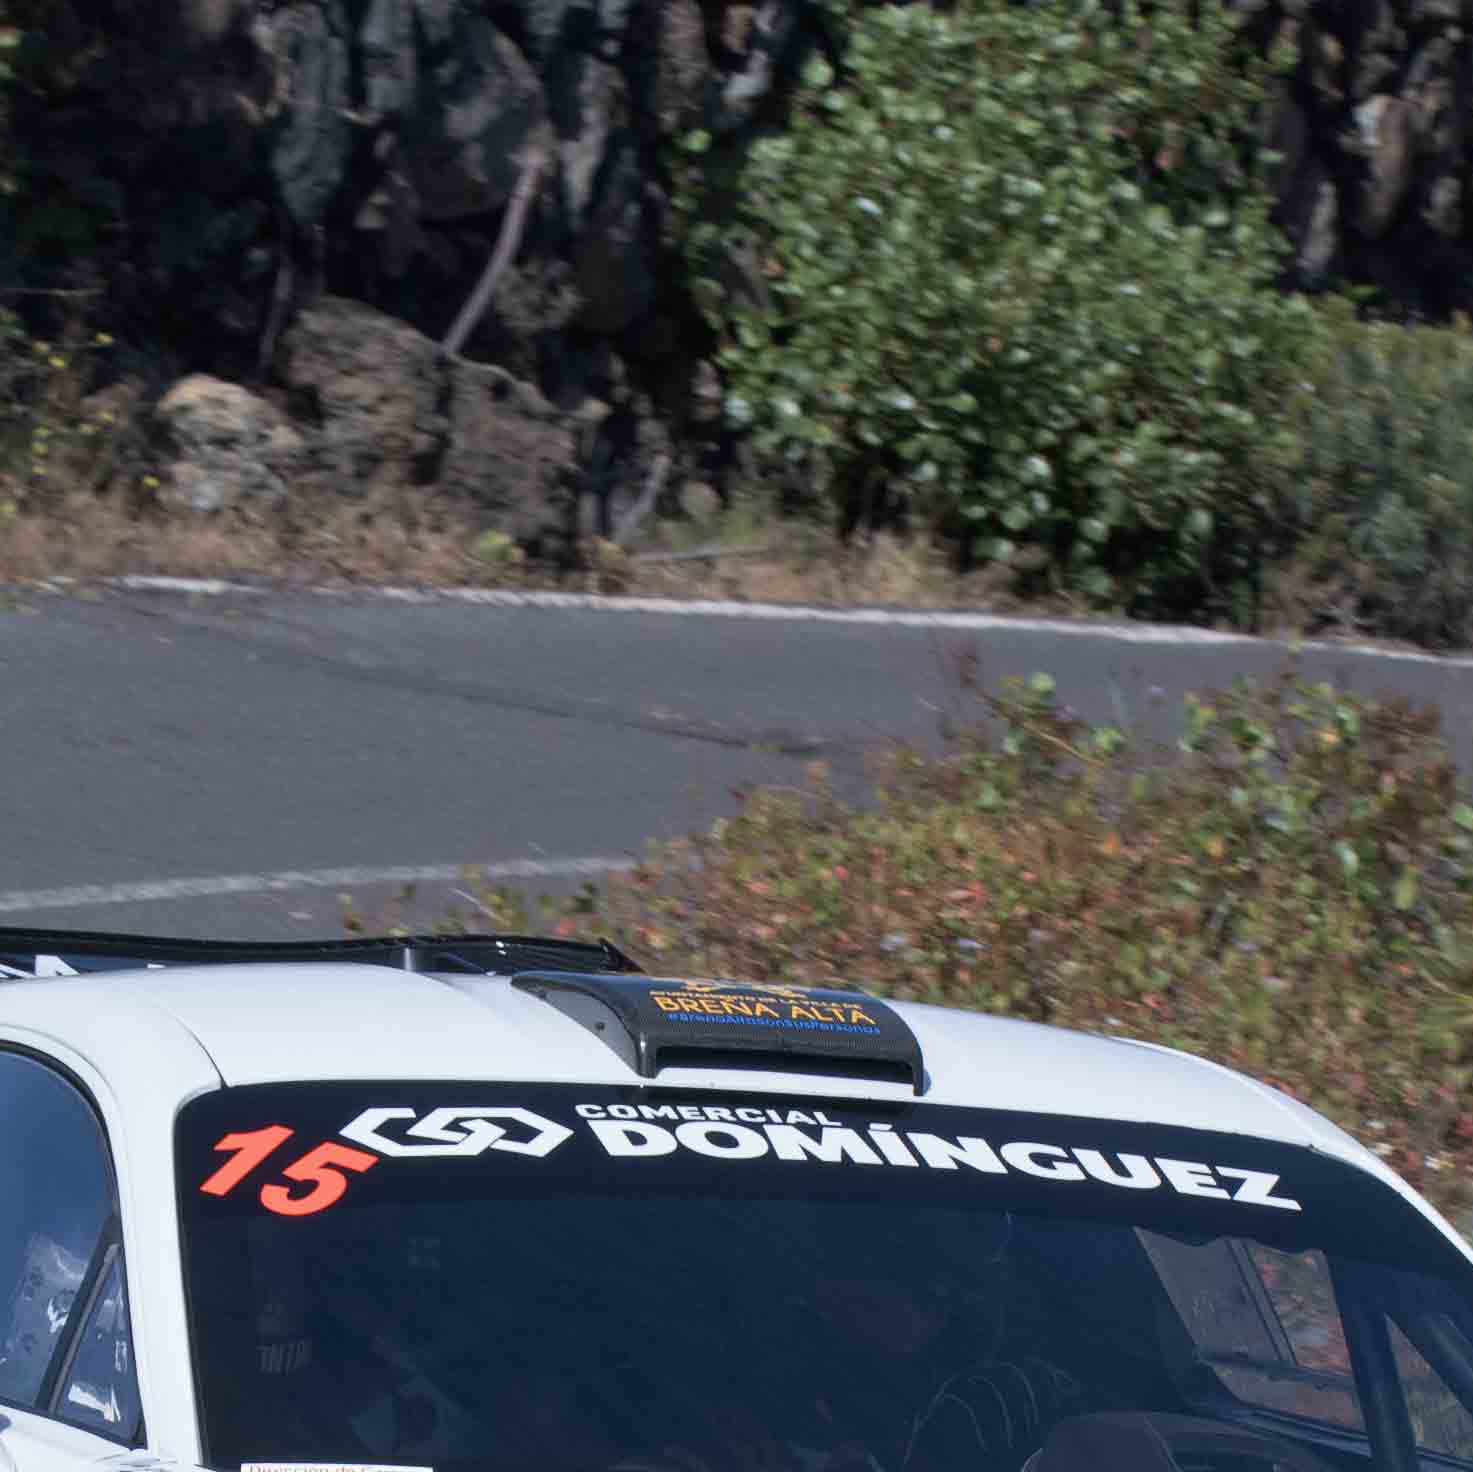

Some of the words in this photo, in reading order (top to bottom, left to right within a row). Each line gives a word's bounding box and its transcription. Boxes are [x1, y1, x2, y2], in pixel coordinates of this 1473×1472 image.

[791, 1004, 877, 1025] ALTA
[574, 1103, 842, 1129] COMERCIAL
[199, 1124, 379, 1217] 15
[585, 1117, 1302, 1212] DOMÍNGUEZ
